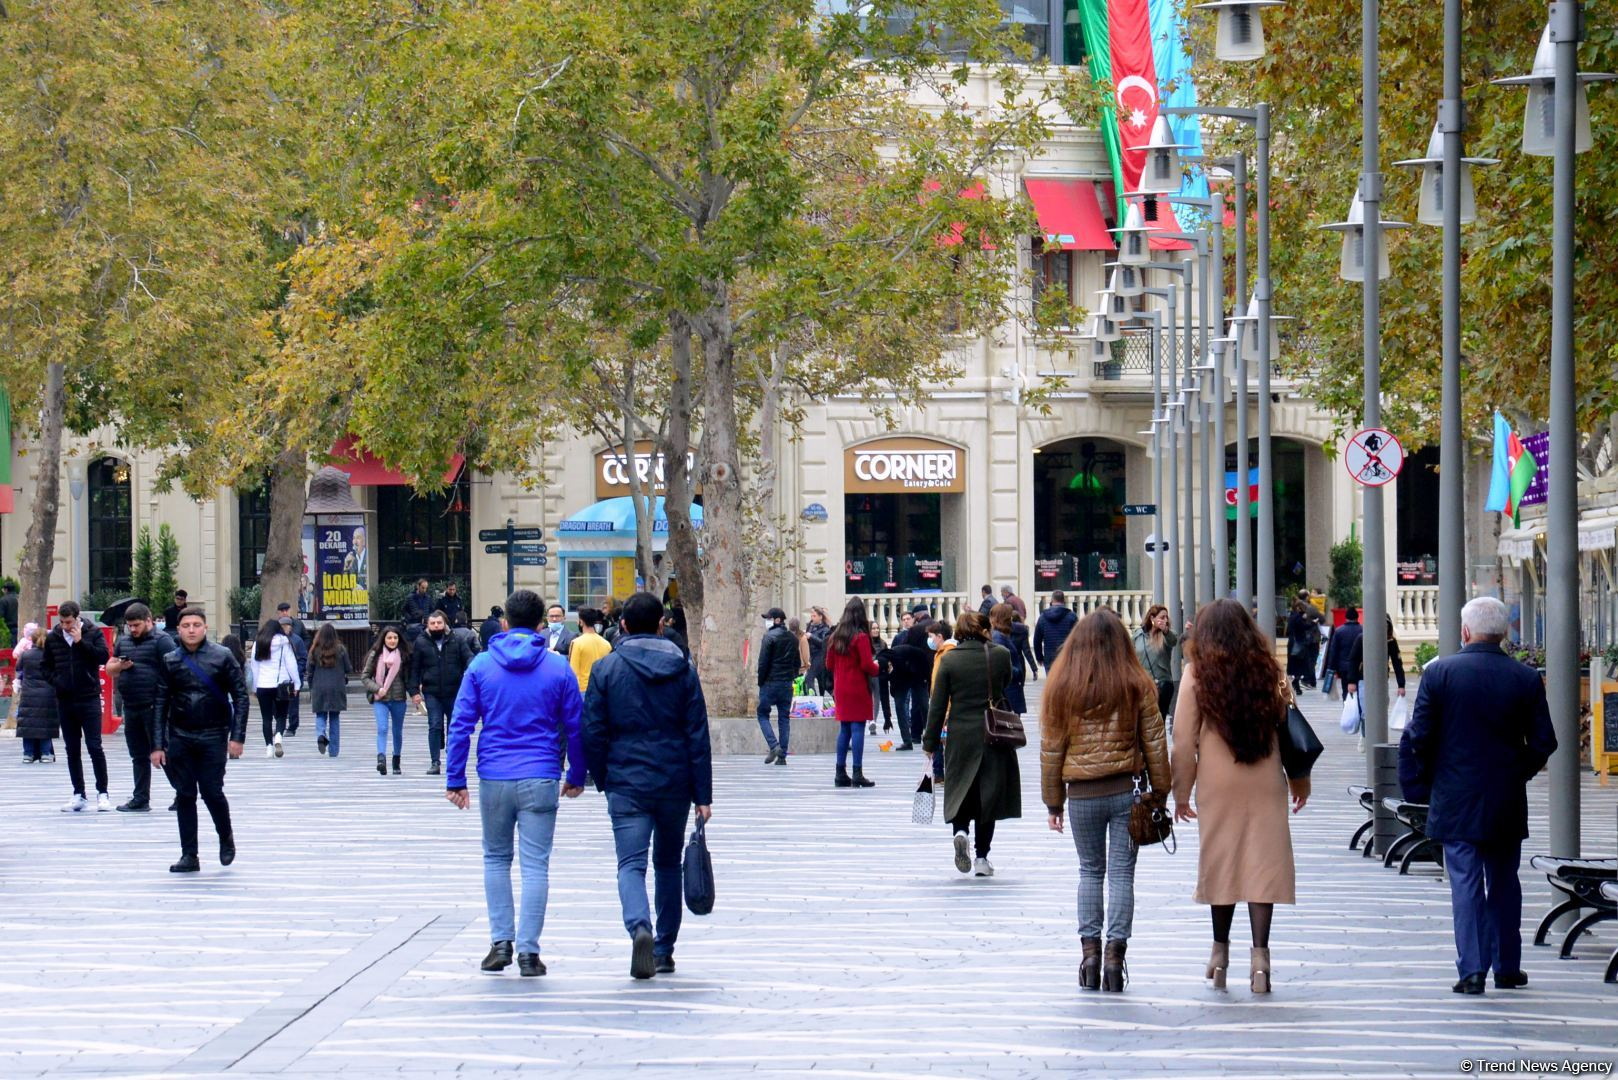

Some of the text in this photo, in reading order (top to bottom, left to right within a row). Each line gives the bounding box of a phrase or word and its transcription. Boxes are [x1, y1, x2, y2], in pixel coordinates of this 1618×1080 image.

[602, 455, 693, 485] CORN
[855, 453, 956, 480] CORNER
[560, 521, 611, 531] DRAGON BREATH
[325, 530, 341, 542] 20
[319, 542, 347, 550] DEKABR
